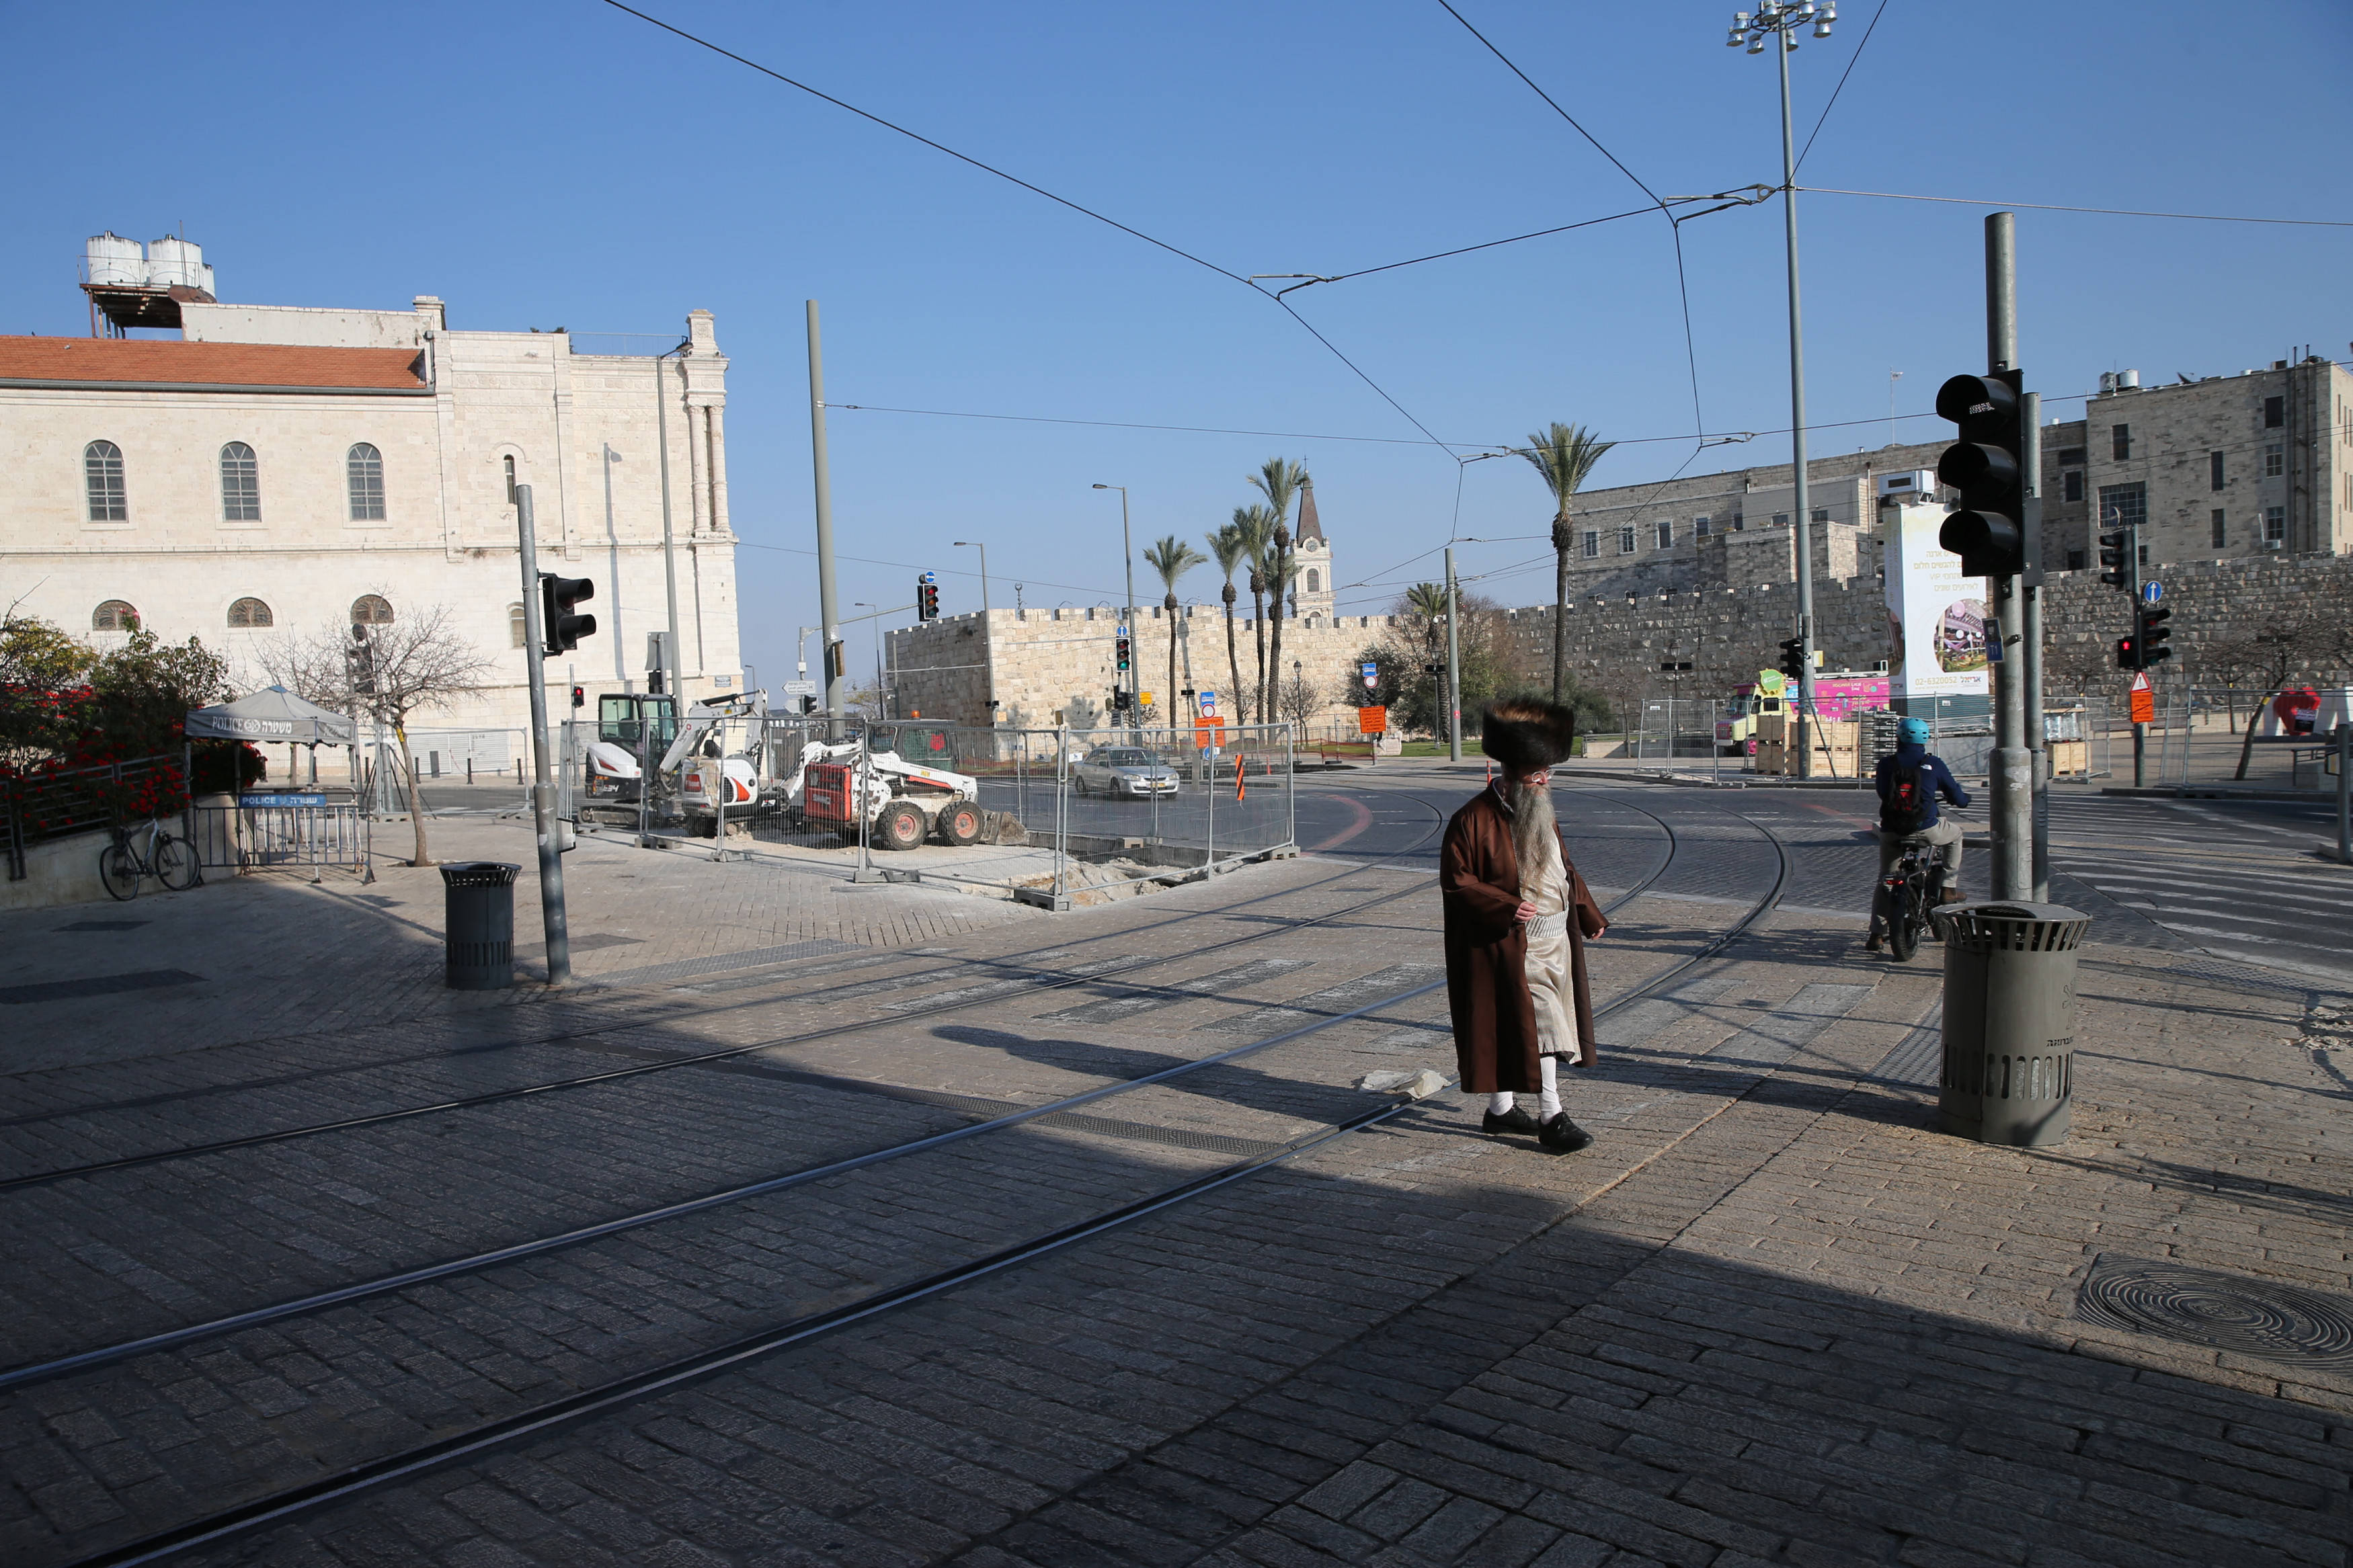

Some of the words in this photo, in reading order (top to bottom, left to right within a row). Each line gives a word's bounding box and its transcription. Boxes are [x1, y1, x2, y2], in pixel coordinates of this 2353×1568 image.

[1915, 676, 1958, 686] 02-6320052
[212, 716, 243, 732] POLICE
[262, 720, 292, 735] משטרה
[242, 796, 276, 804] POLICE
[289, 796, 319, 804] שטרה
